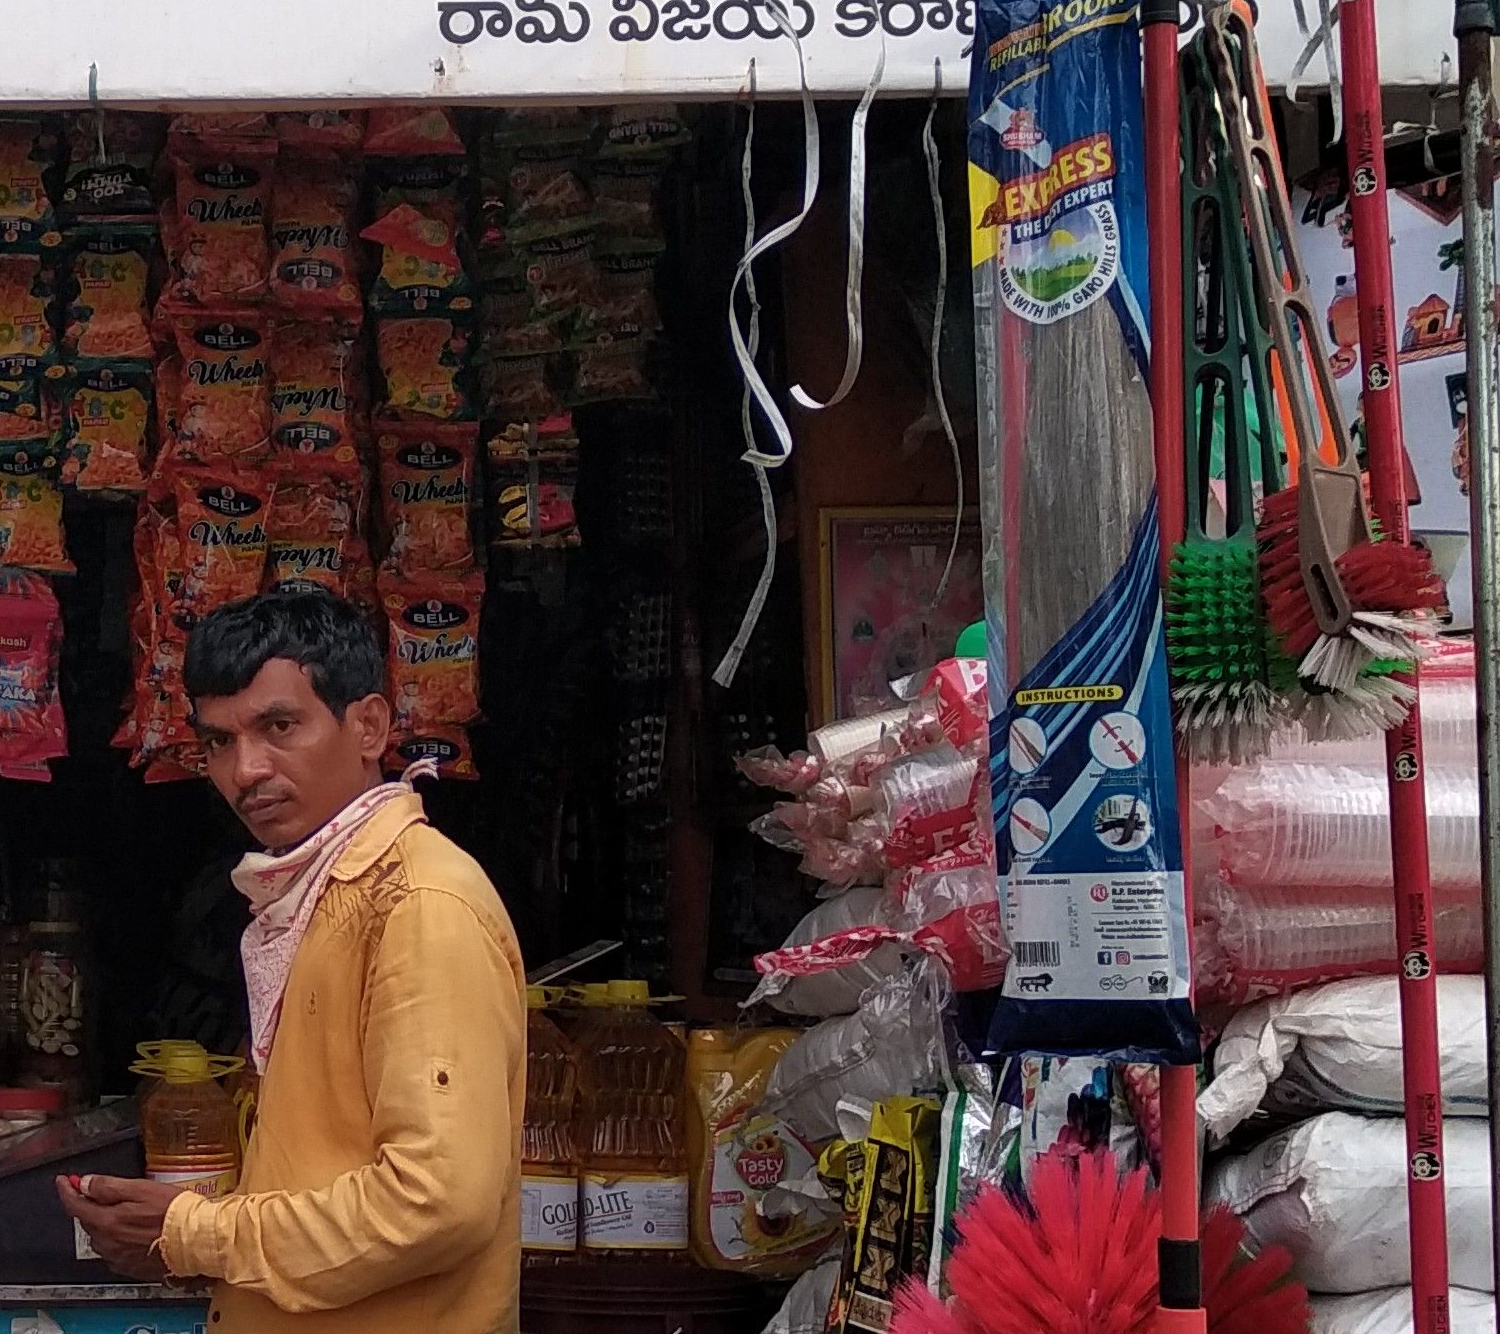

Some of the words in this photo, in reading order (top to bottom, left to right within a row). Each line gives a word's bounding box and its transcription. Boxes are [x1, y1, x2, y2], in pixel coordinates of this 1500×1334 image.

[989, 36, 1047, 73] REFILLAB
[1003, 140, 1113, 218] EXPRESS
[1014, 220, 1042, 239] THE
[1044, 201, 1062, 229] DST
[1064, 179, 1113, 212] EXPERT
[1094, 203, 1117, 242] GRASS
[1100, 244, 1117, 278] HILLS
[999, 268, 1016, 300] MADE
[1072, 276, 1104, 305] GARO
[1012, 293, 1045, 317] WITH
[204, 334, 250, 346] BELL
[407, 453, 452, 465] BELL
[208, 496, 249, 512] BELL
[412, 611, 461, 624] BELL
[1020, 687, 1116, 703] INSTRUCTIONS
[407, 743, 451, 754] BELL
[738, 1157, 784, 1175] Tasty
[748, 1173, 779, 1185] Gold
